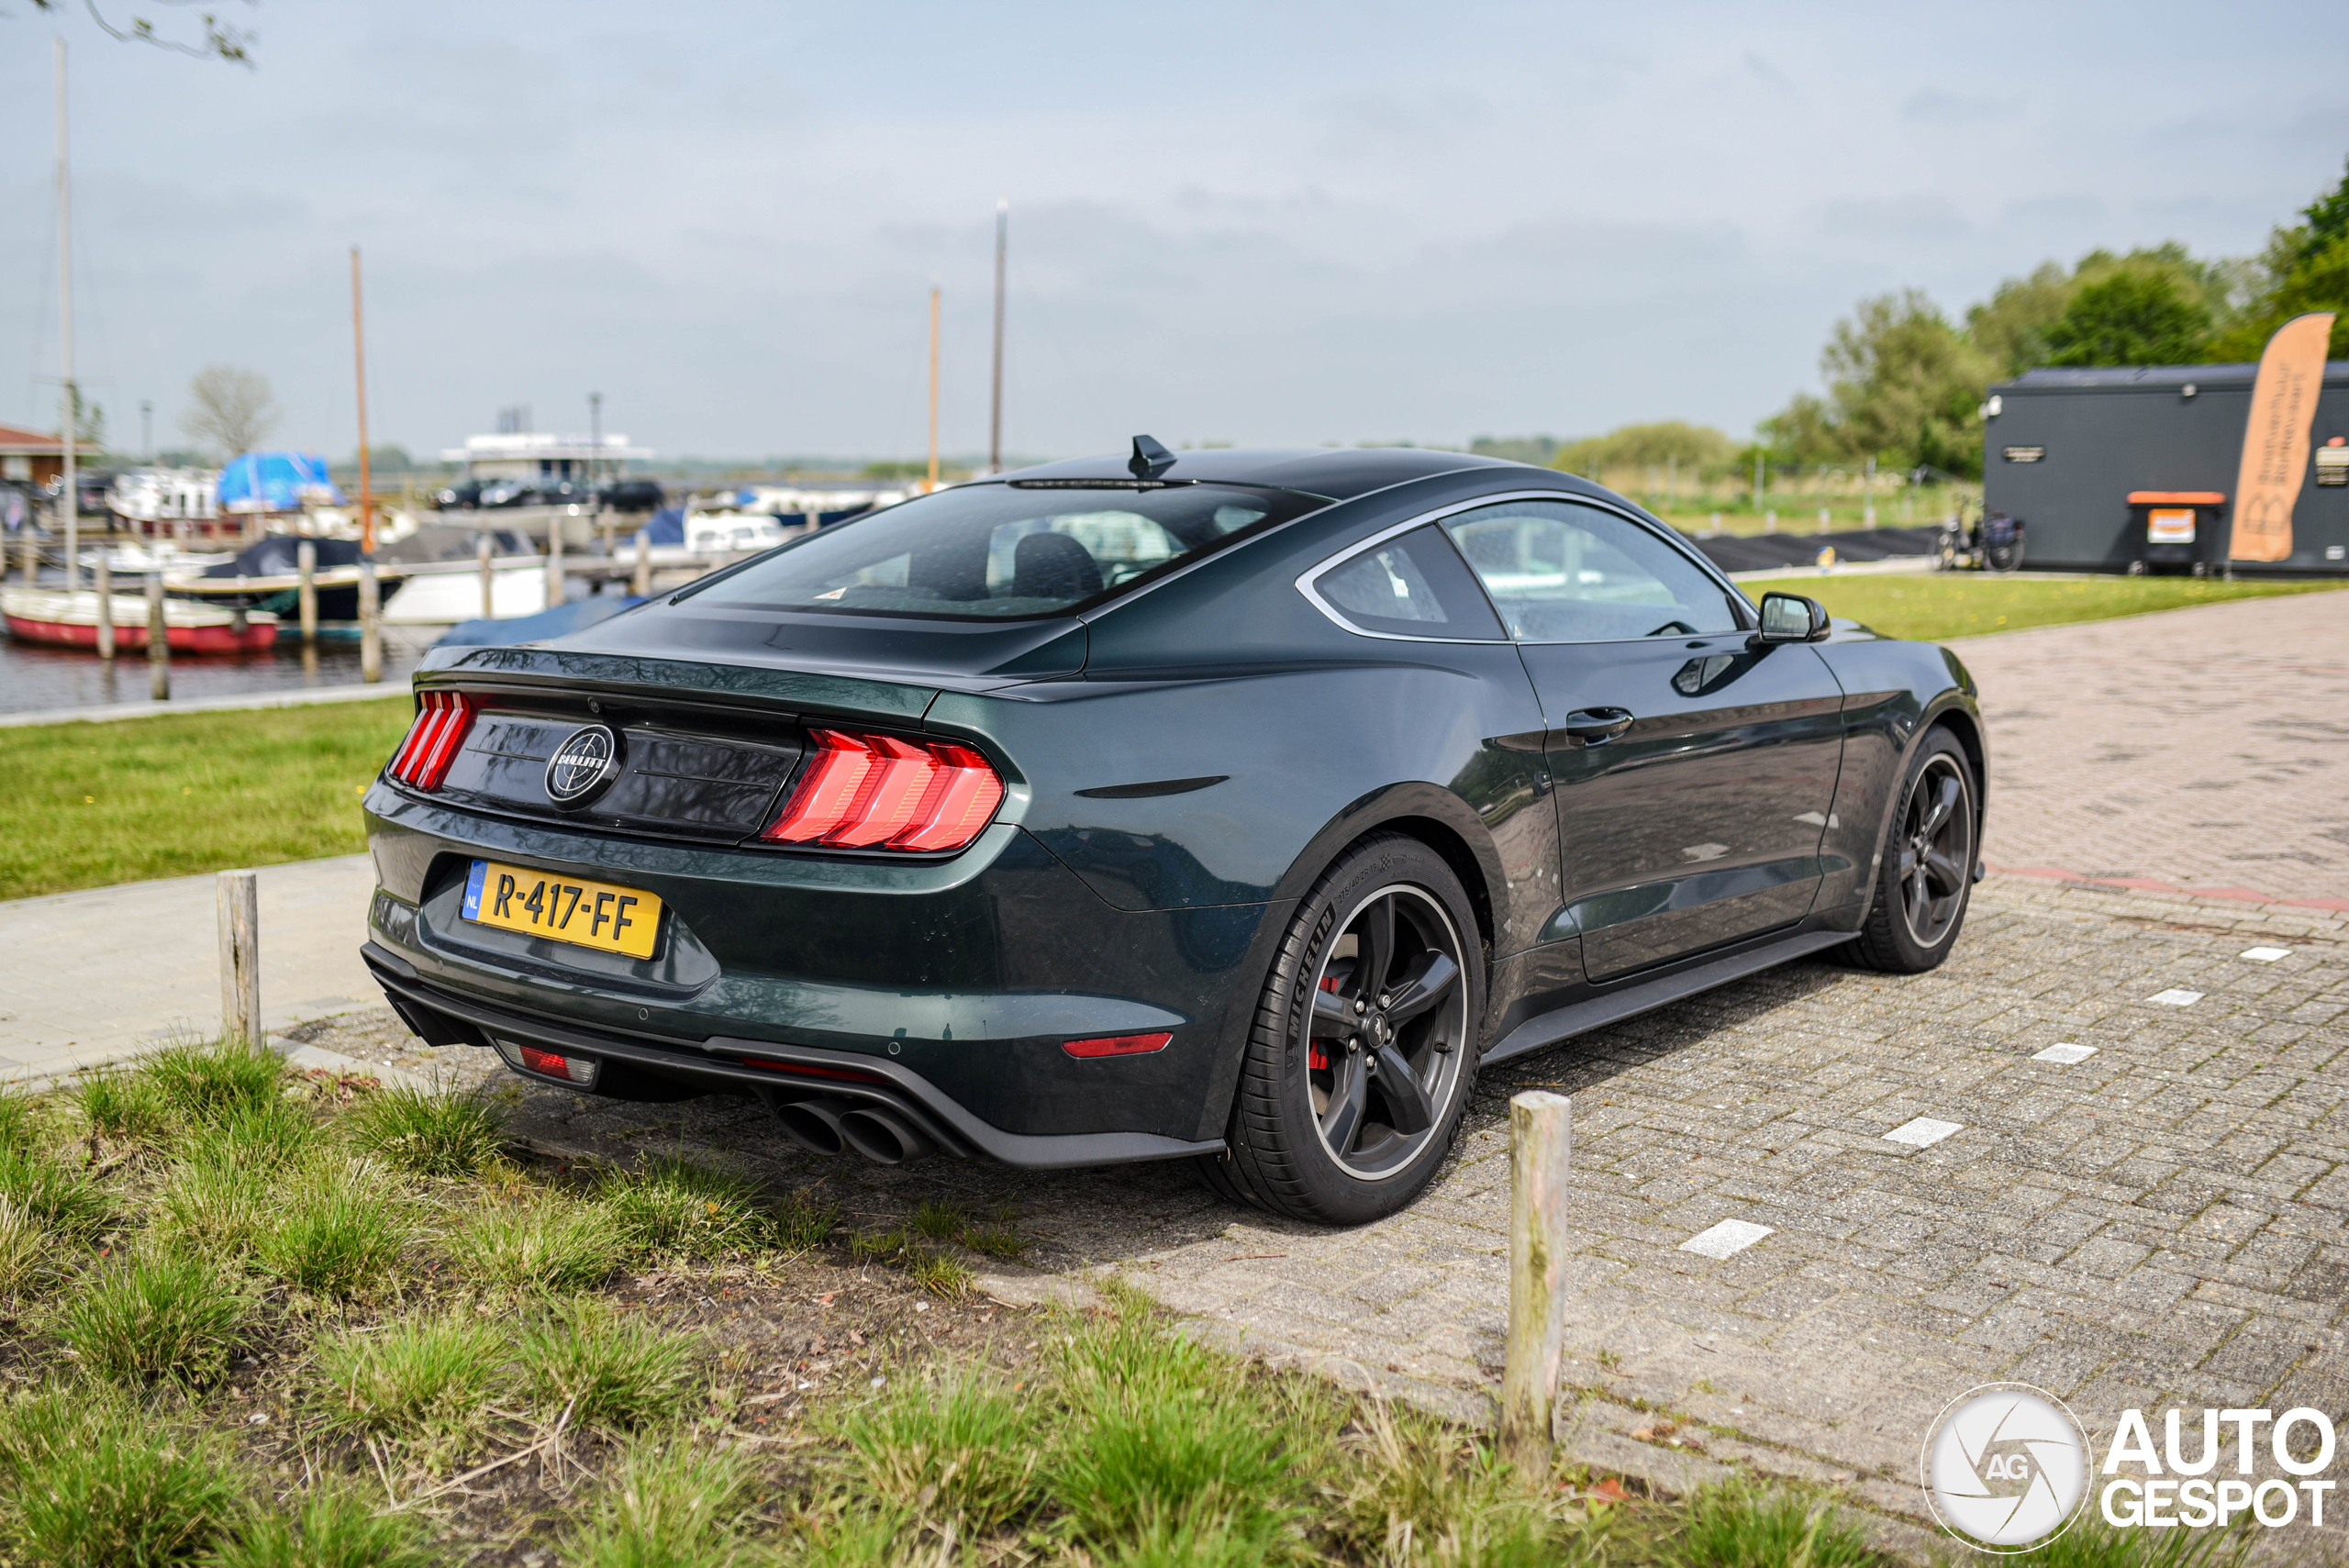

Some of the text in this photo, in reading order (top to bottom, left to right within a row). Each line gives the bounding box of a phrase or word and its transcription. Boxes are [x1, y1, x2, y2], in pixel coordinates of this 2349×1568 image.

[557, 754, 607, 769] BULLITT
[466, 895, 478, 910] NL
[1338, 862, 1377, 904] 275/40 ZR 19
[493, 873, 638, 940] R-417-FF
[1287, 910, 1334, 1040] MICHELIN
